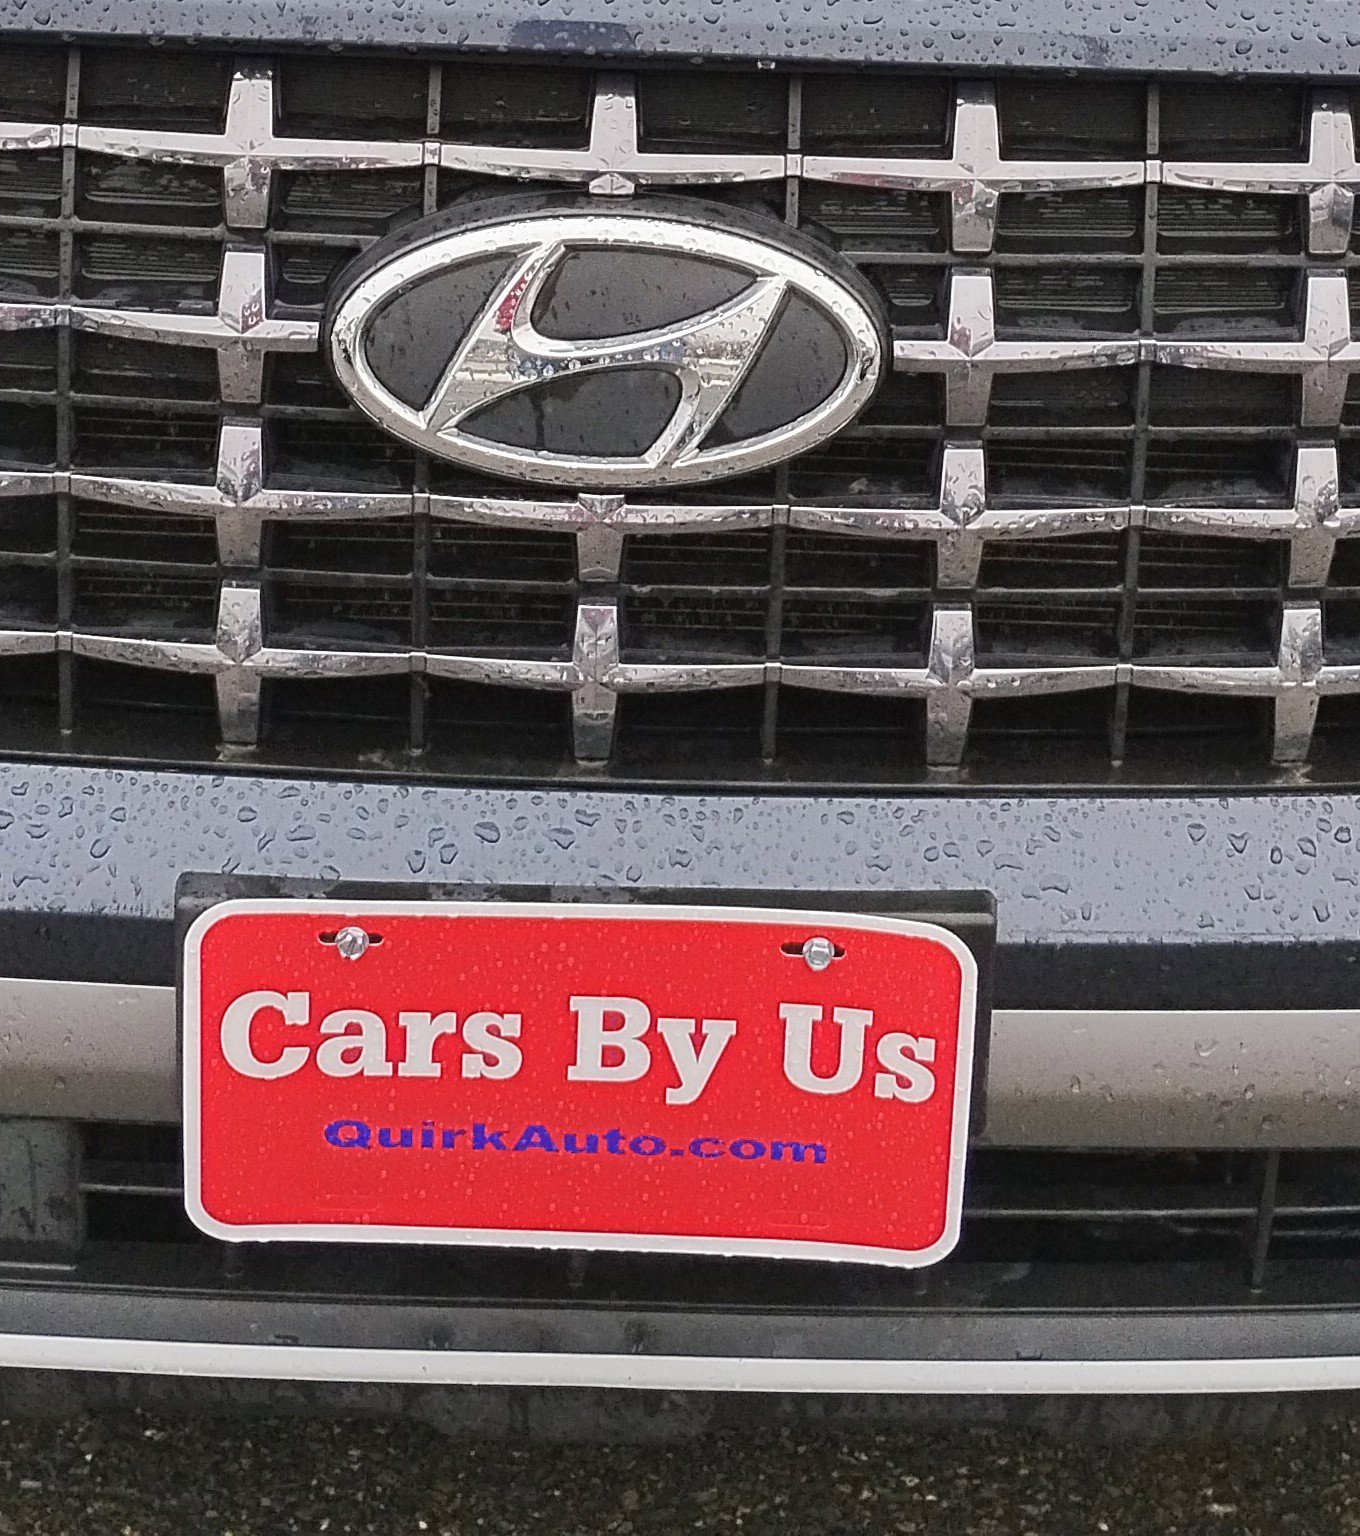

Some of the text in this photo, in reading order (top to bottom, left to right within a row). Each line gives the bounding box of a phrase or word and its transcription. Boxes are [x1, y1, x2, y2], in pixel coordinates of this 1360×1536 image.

[220, 990, 937, 1106] Cars By Us
[323, 1119, 828, 1165] QuirkAuto.com
